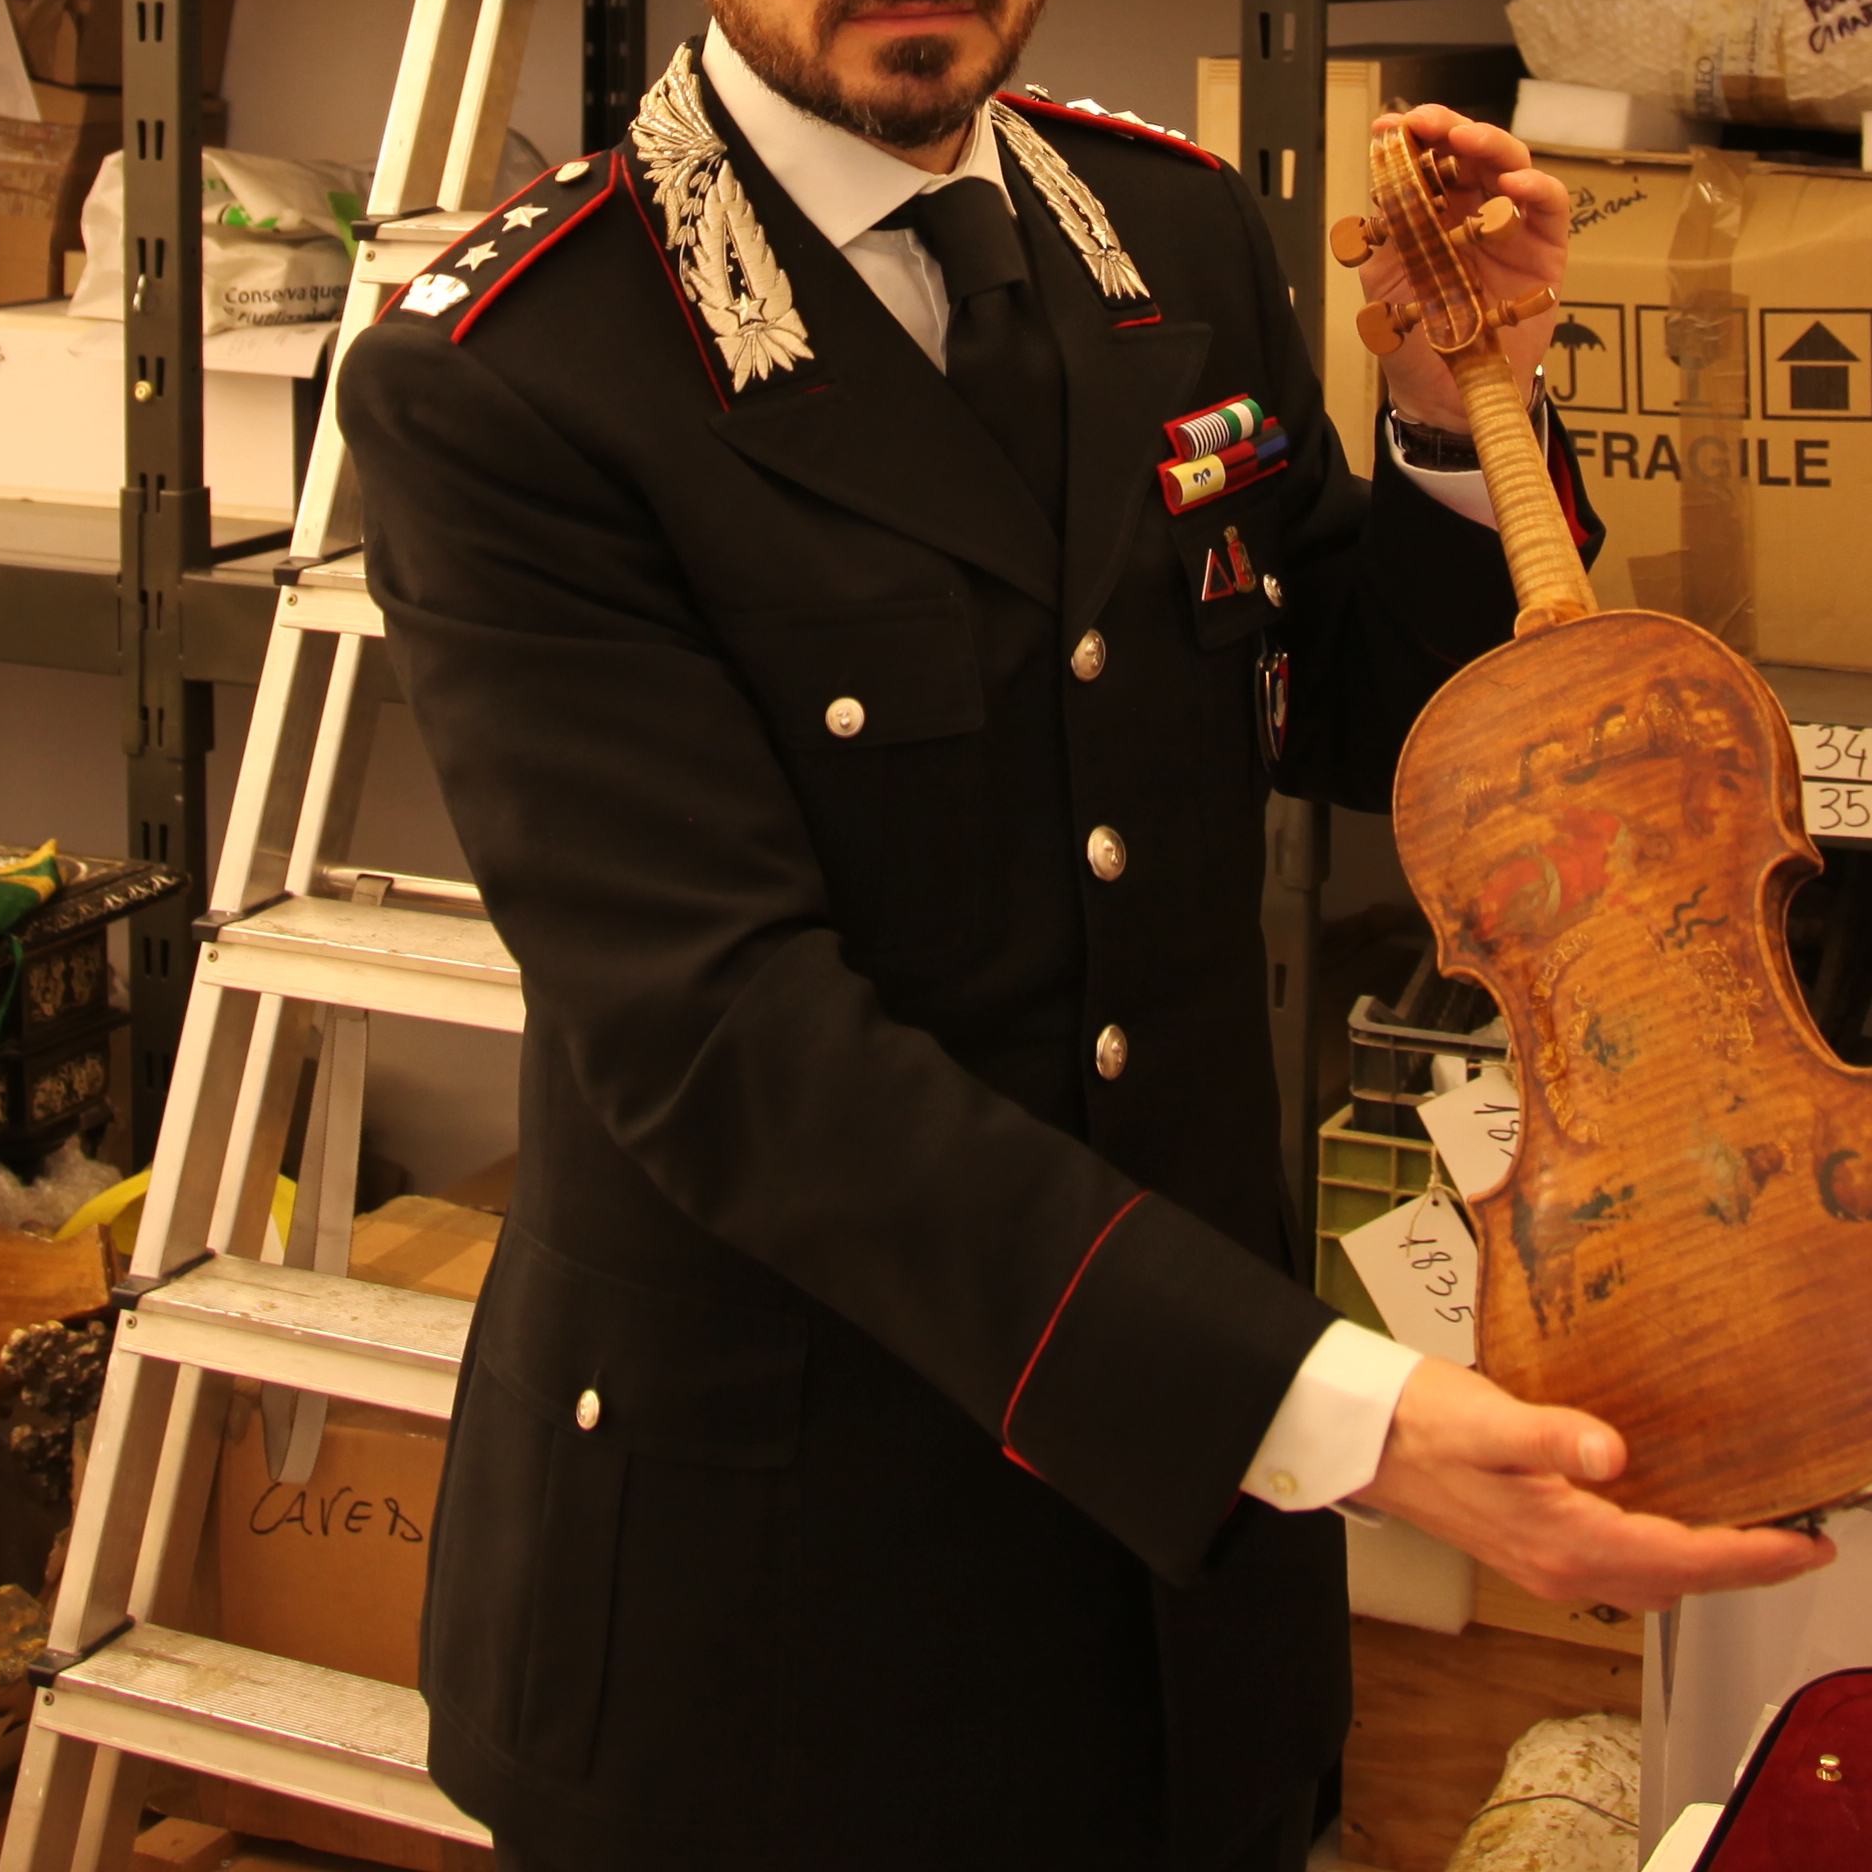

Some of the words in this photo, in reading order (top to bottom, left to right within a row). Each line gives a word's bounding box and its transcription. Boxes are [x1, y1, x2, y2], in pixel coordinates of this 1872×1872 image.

[225, 284, 307, 305] Conserva
[1564, 430, 1833, 489] FRAGILE
[1813, 727, 1870, 779] 34
[1397, 1235, 1476, 1324] 1835
